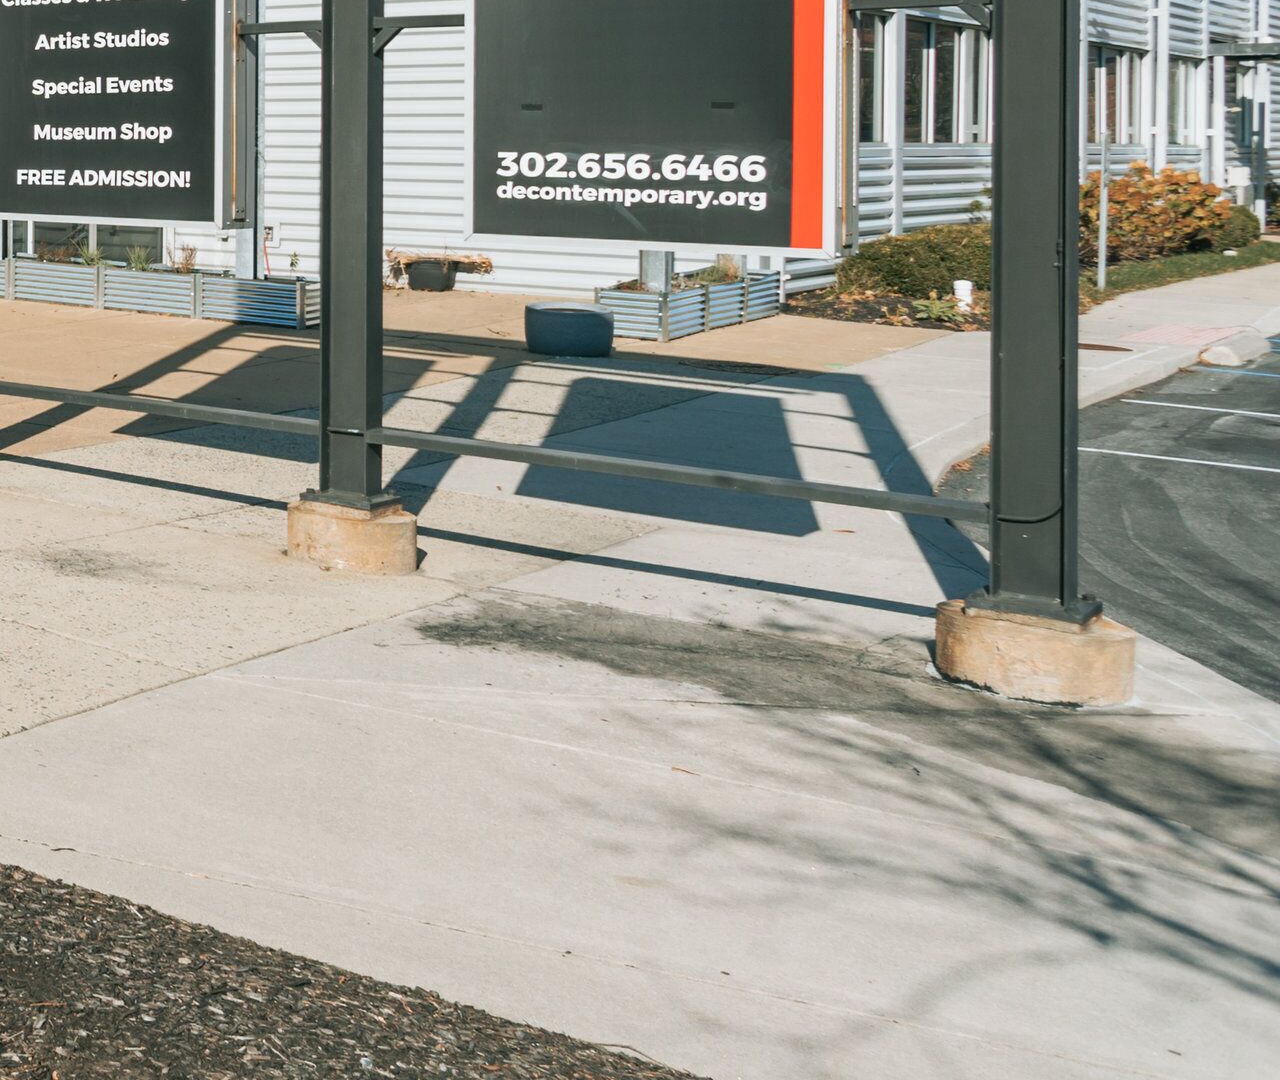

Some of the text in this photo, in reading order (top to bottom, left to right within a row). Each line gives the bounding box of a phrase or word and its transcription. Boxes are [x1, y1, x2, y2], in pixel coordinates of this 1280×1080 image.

[34, 28, 170, 50] Artist Studios
[32, 76, 174, 98] Special Events
[33, 122, 173, 143] Museum Shop
[496, 151, 767, 182] 302.656.6466
[16, 169, 191, 188] FREE ADMISSION!
[496, 181, 767, 211] decontemporary.org
